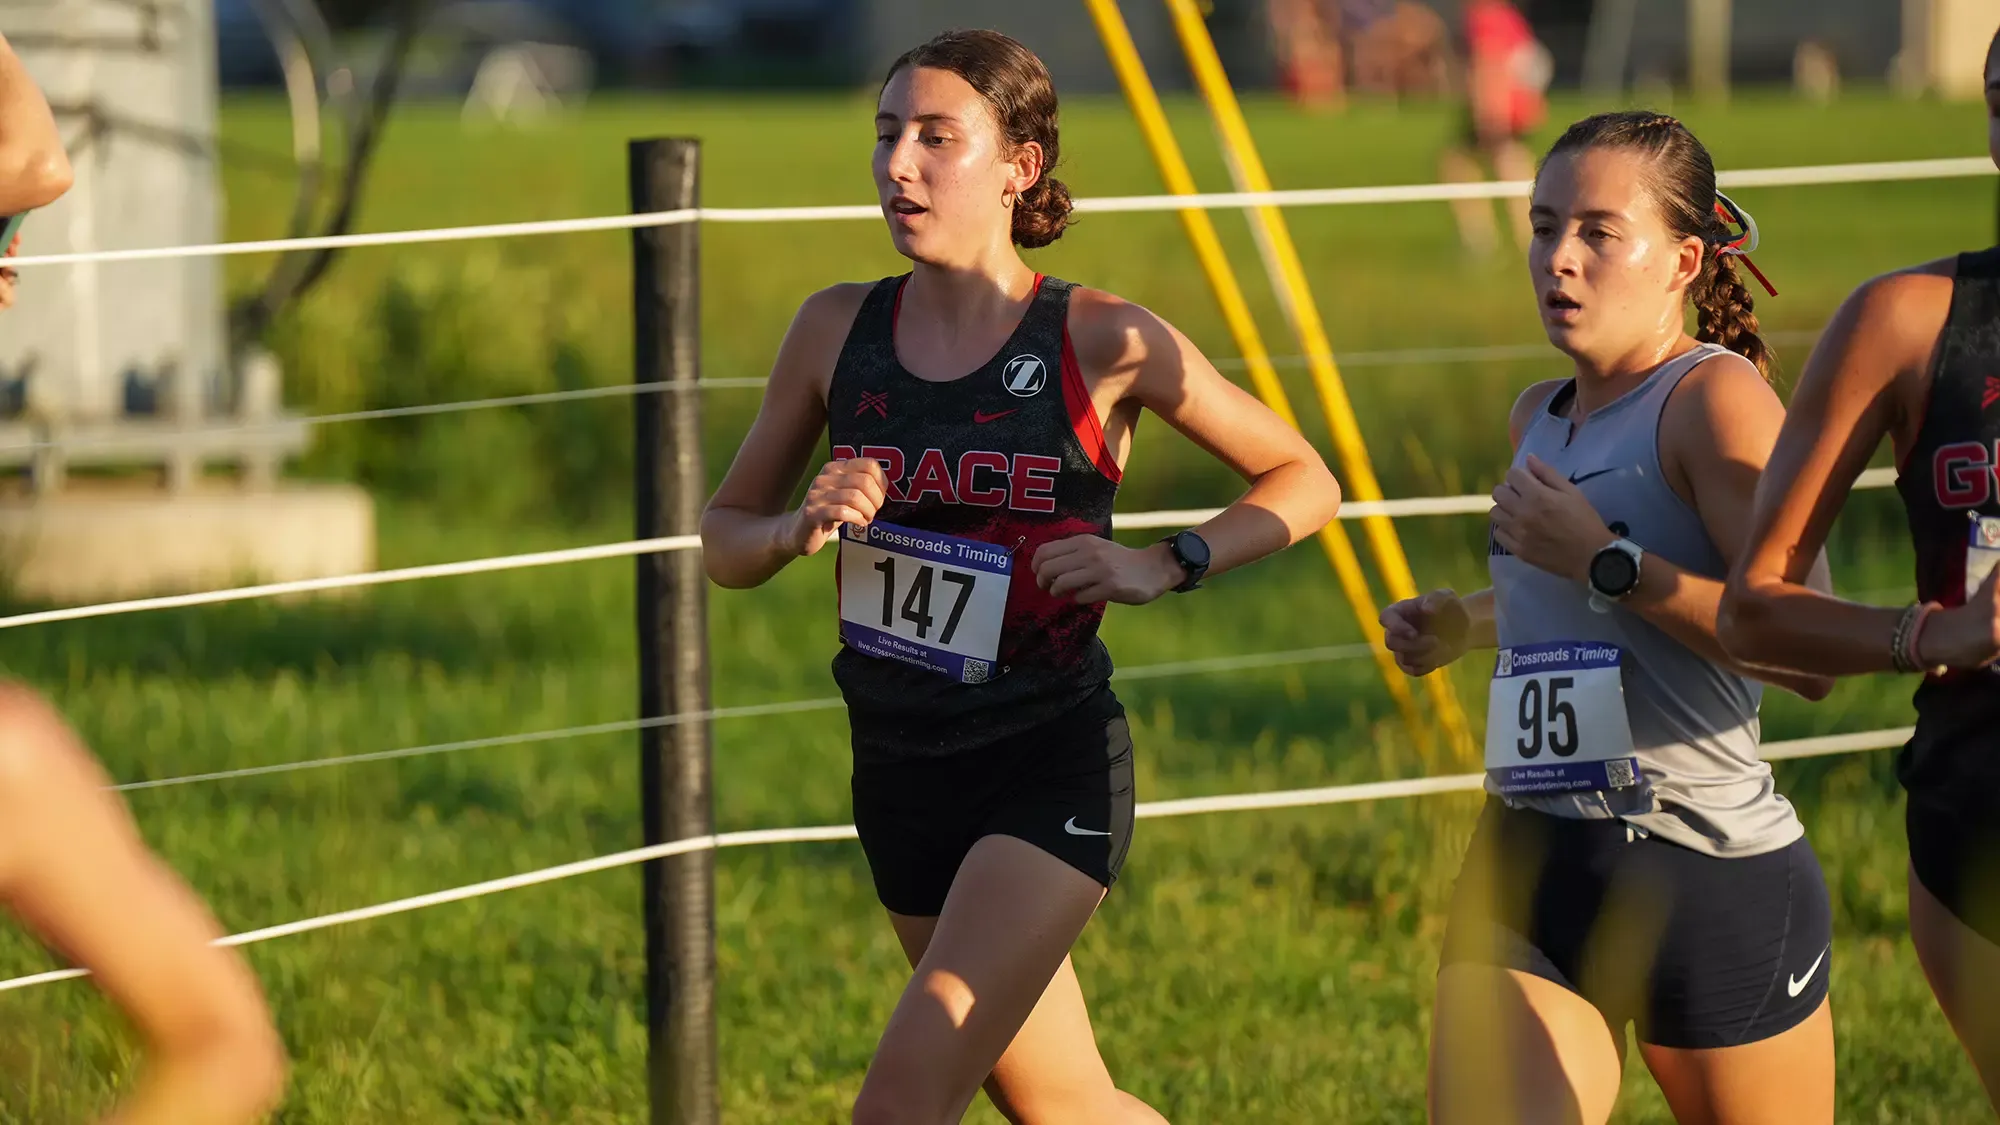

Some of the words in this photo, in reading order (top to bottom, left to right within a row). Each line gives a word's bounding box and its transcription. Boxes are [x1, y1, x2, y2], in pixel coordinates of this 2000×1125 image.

[833, 445, 1062, 513] RACE
[870, 526, 952, 555] Crossroads
[956, 543, 1008, 568] Timing
[874, 556, 976, 645] 147
[857, 640, 948, 675] live.crossroadstiming.com
[878, 635, 892, 647] Live
[892, 640, 919, 656] Results
[919, 650, 927, 658] at
[1512, 648, 1570, 667] Crossroads
[1573, 646, 1619, 662] Timing
[1517, 677, 1579, 760] 95
[1511, 771, 1526, 780] Live
[1526, 769, 1556, 780] Results
[1556, 768, 1566, 777] at
